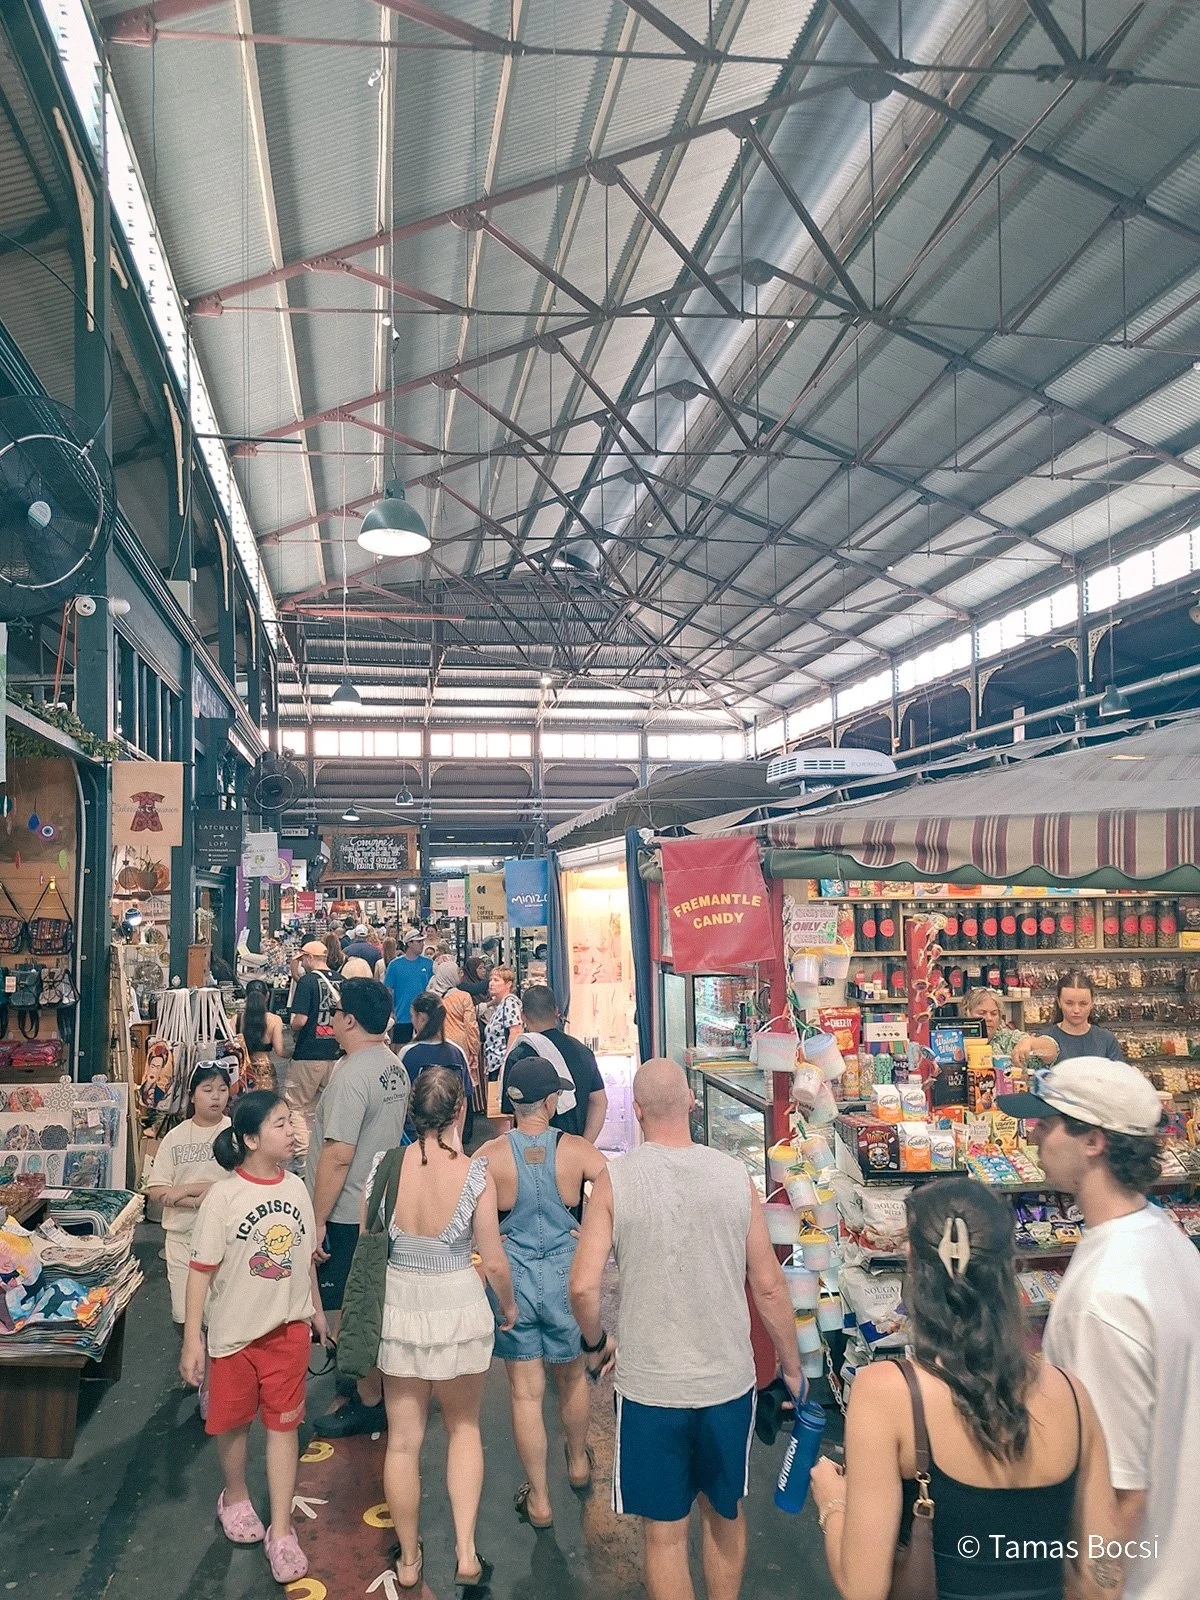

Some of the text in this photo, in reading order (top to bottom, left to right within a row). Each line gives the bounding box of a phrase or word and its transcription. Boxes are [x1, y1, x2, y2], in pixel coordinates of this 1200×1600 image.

[672, 893, 762, 918] FREMANTLE
[693, 912, 745, 930] CANDY
[792, 921, 821, 931] ONLY
[777, 1434, 799, 1492] NUTRITION
